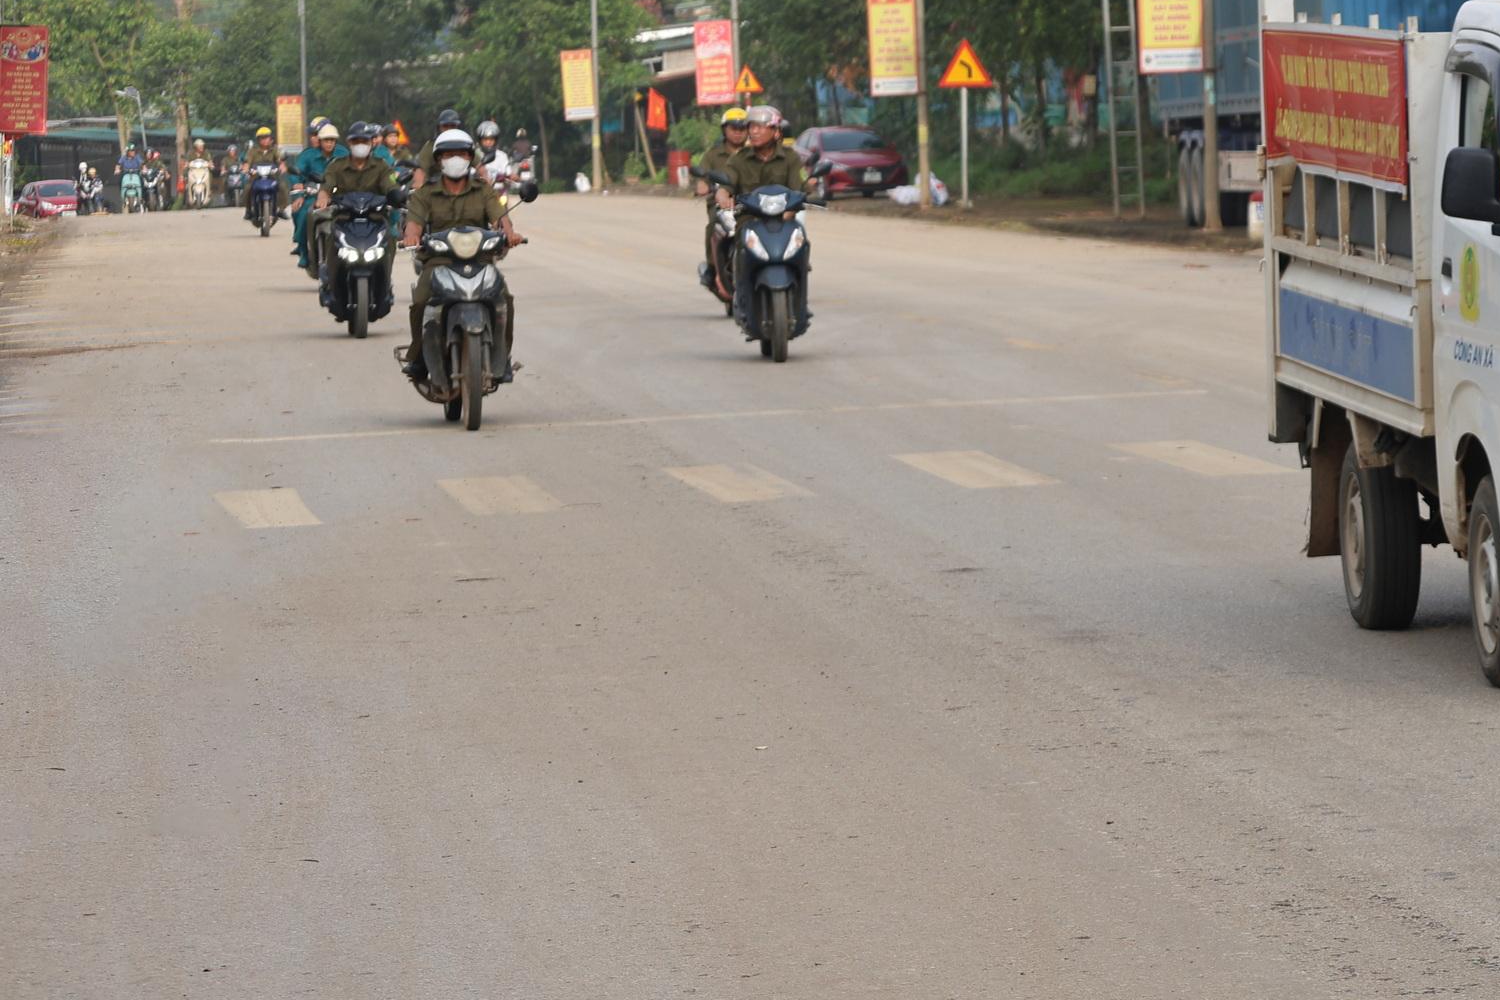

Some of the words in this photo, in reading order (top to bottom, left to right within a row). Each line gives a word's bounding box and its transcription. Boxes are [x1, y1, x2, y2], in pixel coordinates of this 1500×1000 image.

[1453, 337, 1473, 363] CÔNG
[1472, 344, 1483, 365] AN
[1482, 343, 1494, 368] XÃ
